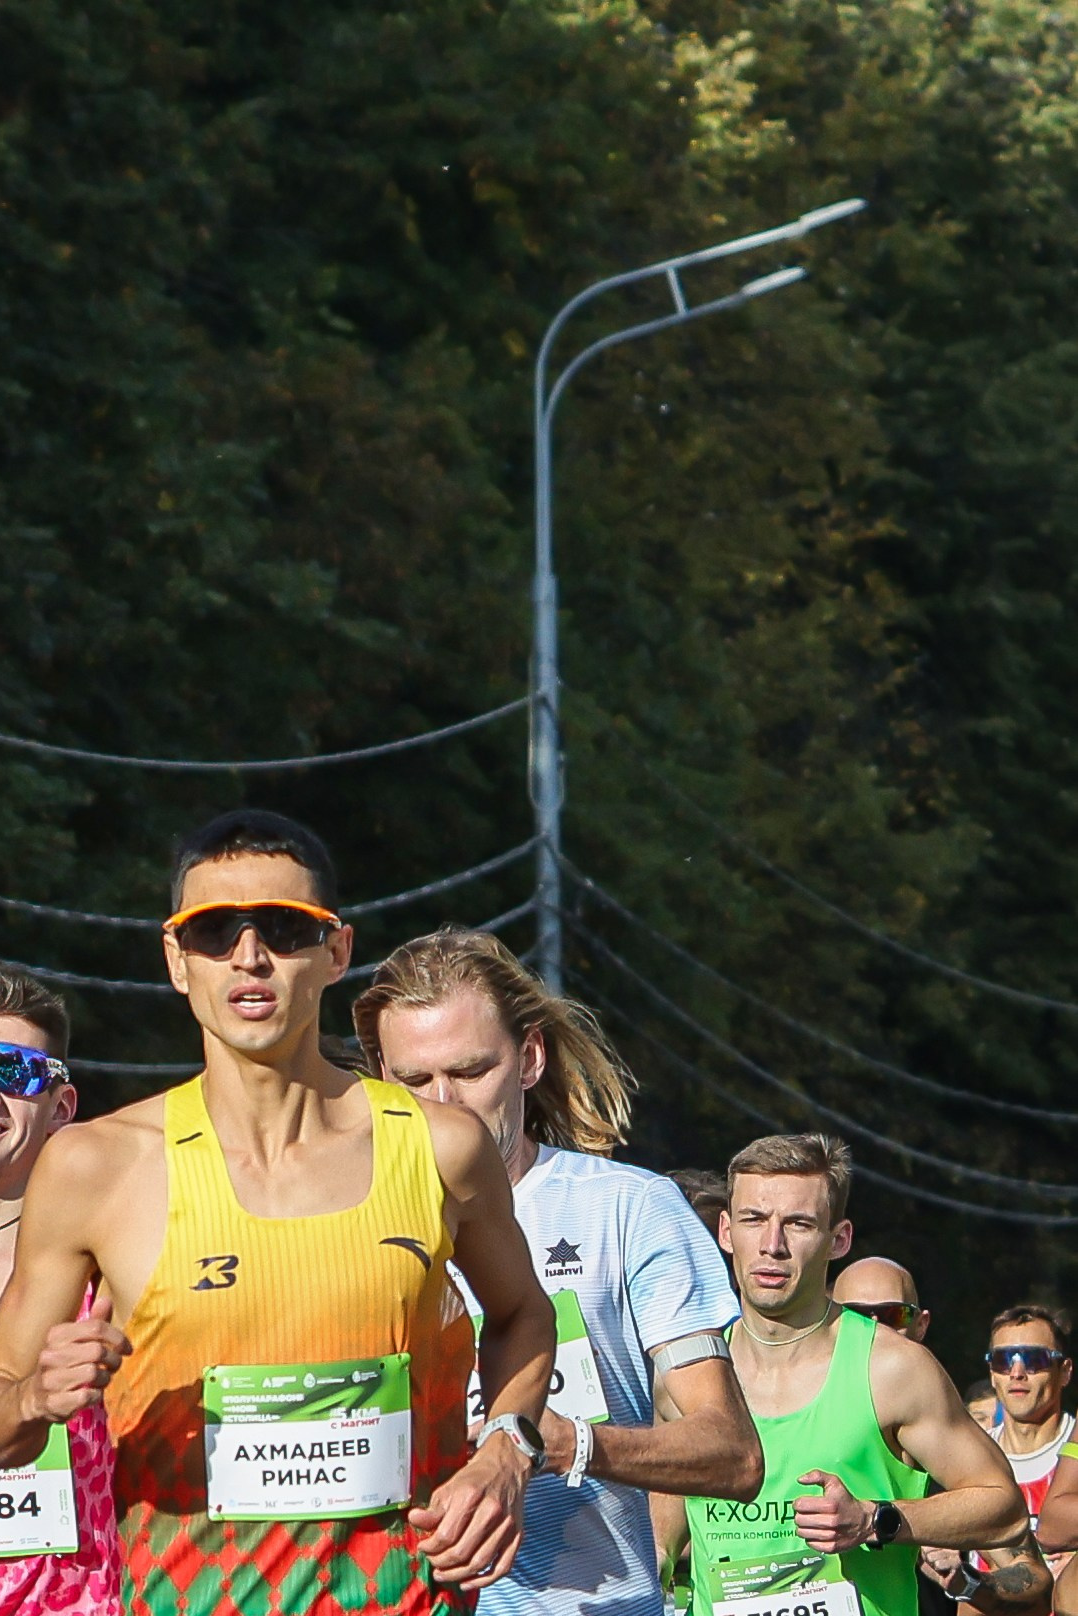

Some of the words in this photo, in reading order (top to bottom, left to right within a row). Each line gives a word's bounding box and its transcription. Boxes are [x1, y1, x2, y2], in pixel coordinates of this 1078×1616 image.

[233, 1438, 371, 1462] АХМАДЕЕВ
[262, 1466, 347, 1487] РИНАС
[706, 1531, 741, 1541] группа
[743, 1529, 798, 1539] компани
